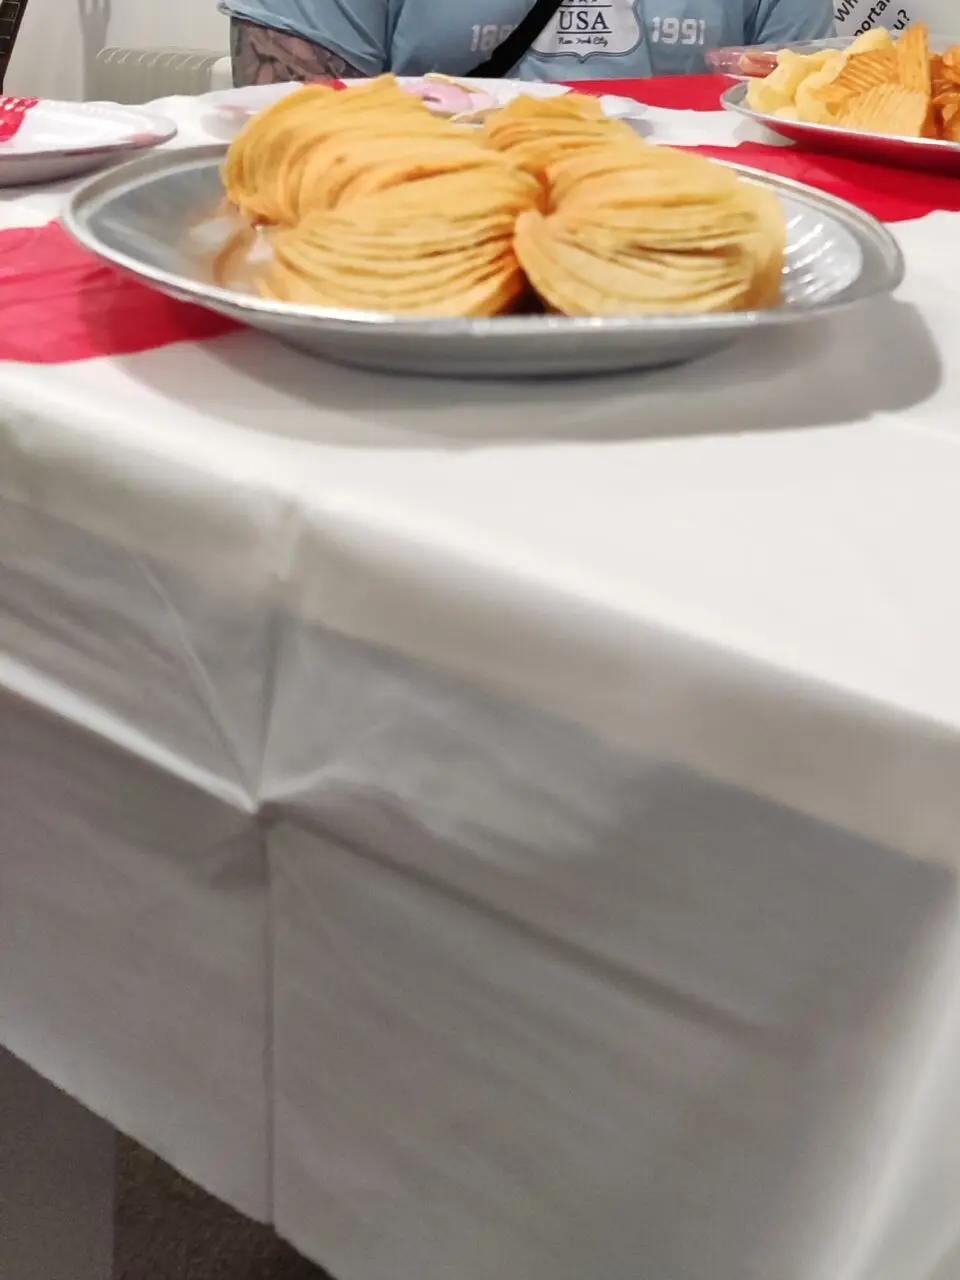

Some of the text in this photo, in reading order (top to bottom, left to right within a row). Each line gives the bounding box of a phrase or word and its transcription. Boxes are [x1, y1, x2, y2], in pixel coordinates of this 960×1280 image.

[559, 10, 610, 30] USA
[892, 8, 910, 31] u?
[470, 17, 705, 52] 18 1991
